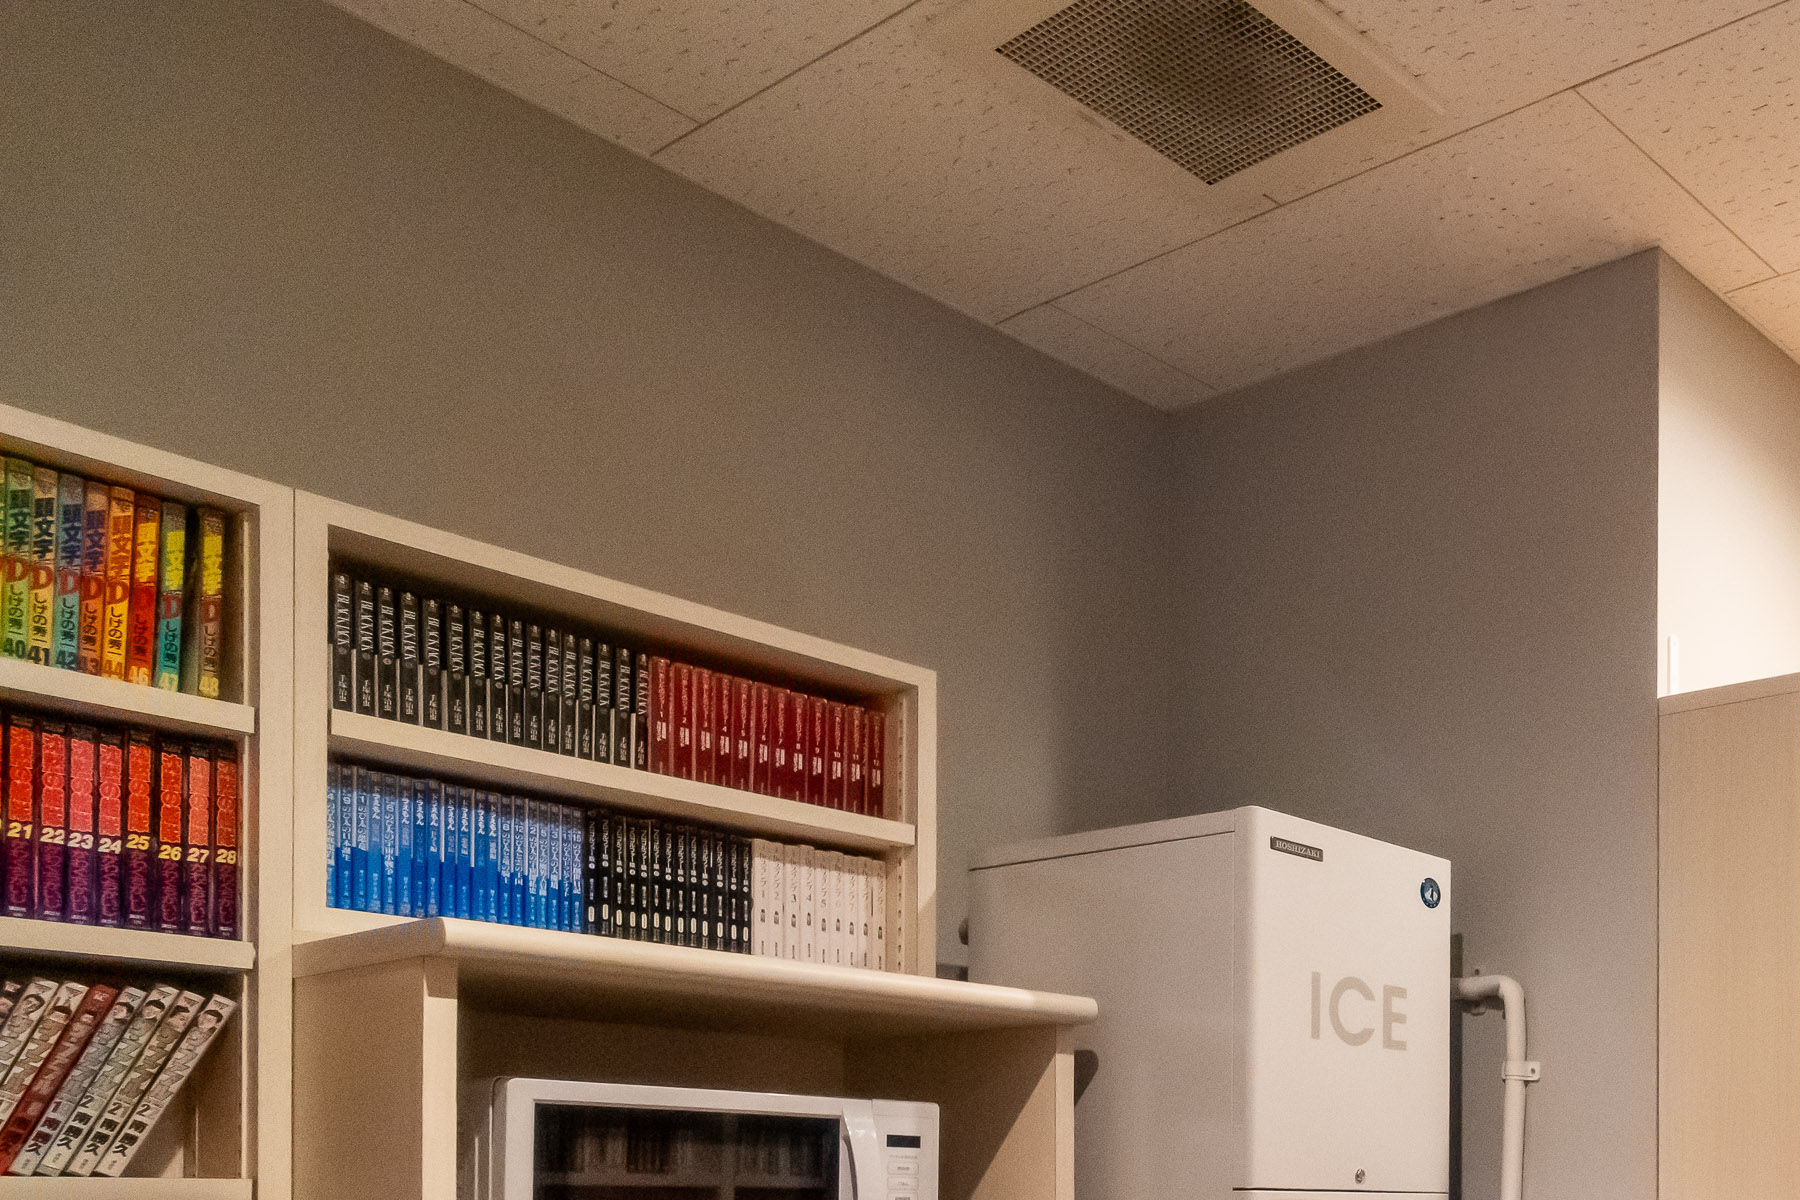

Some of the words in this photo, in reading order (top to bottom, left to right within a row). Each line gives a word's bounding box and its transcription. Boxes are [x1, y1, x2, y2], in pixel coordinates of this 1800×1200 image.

[4, 640, 26, 659] 40
[26, 646, 50, 666] 41
[56, 650, 78, 672] 42
[128, 666, 150, 686] 46
[158, 673, 180, 692] 47
[199, 676, 220, 698] 48
[8, 822, 33, 840] 21
[40, 827, 66, 845] 22
[67, 832, 94, 850] 23
[98, 838, 122, 854] 24
[126, 834, 150, 851] 25
[1276, 840, 1320, 858] HOSHIZAKI
[158, 844, 182, 860] 26
[186, 848, 210, 864] 27
[216, 849, 237, 864] 28
[1311, 971, 1408, 1051] ICE
